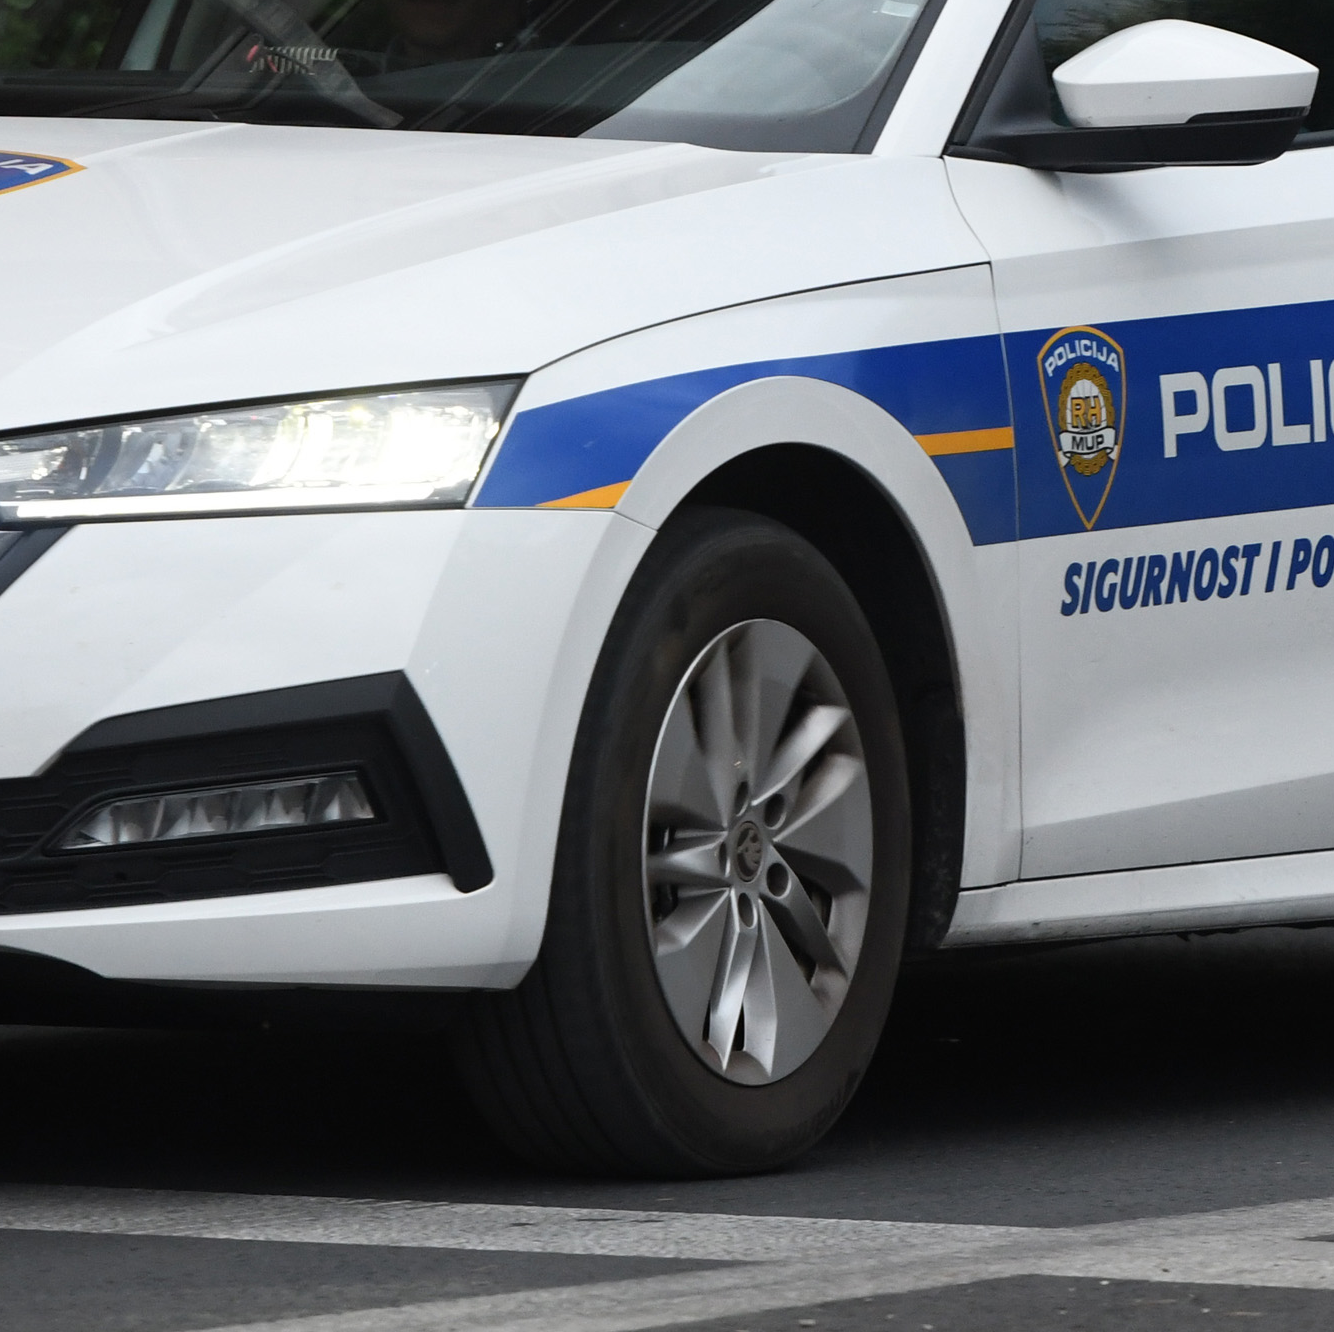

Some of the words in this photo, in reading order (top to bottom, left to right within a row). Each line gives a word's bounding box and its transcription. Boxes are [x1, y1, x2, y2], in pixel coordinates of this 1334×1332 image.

[1044, 339, 1120, 377] POLICIJA
[1071, 396, 1102, 429] RH
[1071, 434, 1105, 451] MUP
[1060, 542, 1262, 617] SIGURNOST
[1265, 540, 1282, 593] I
